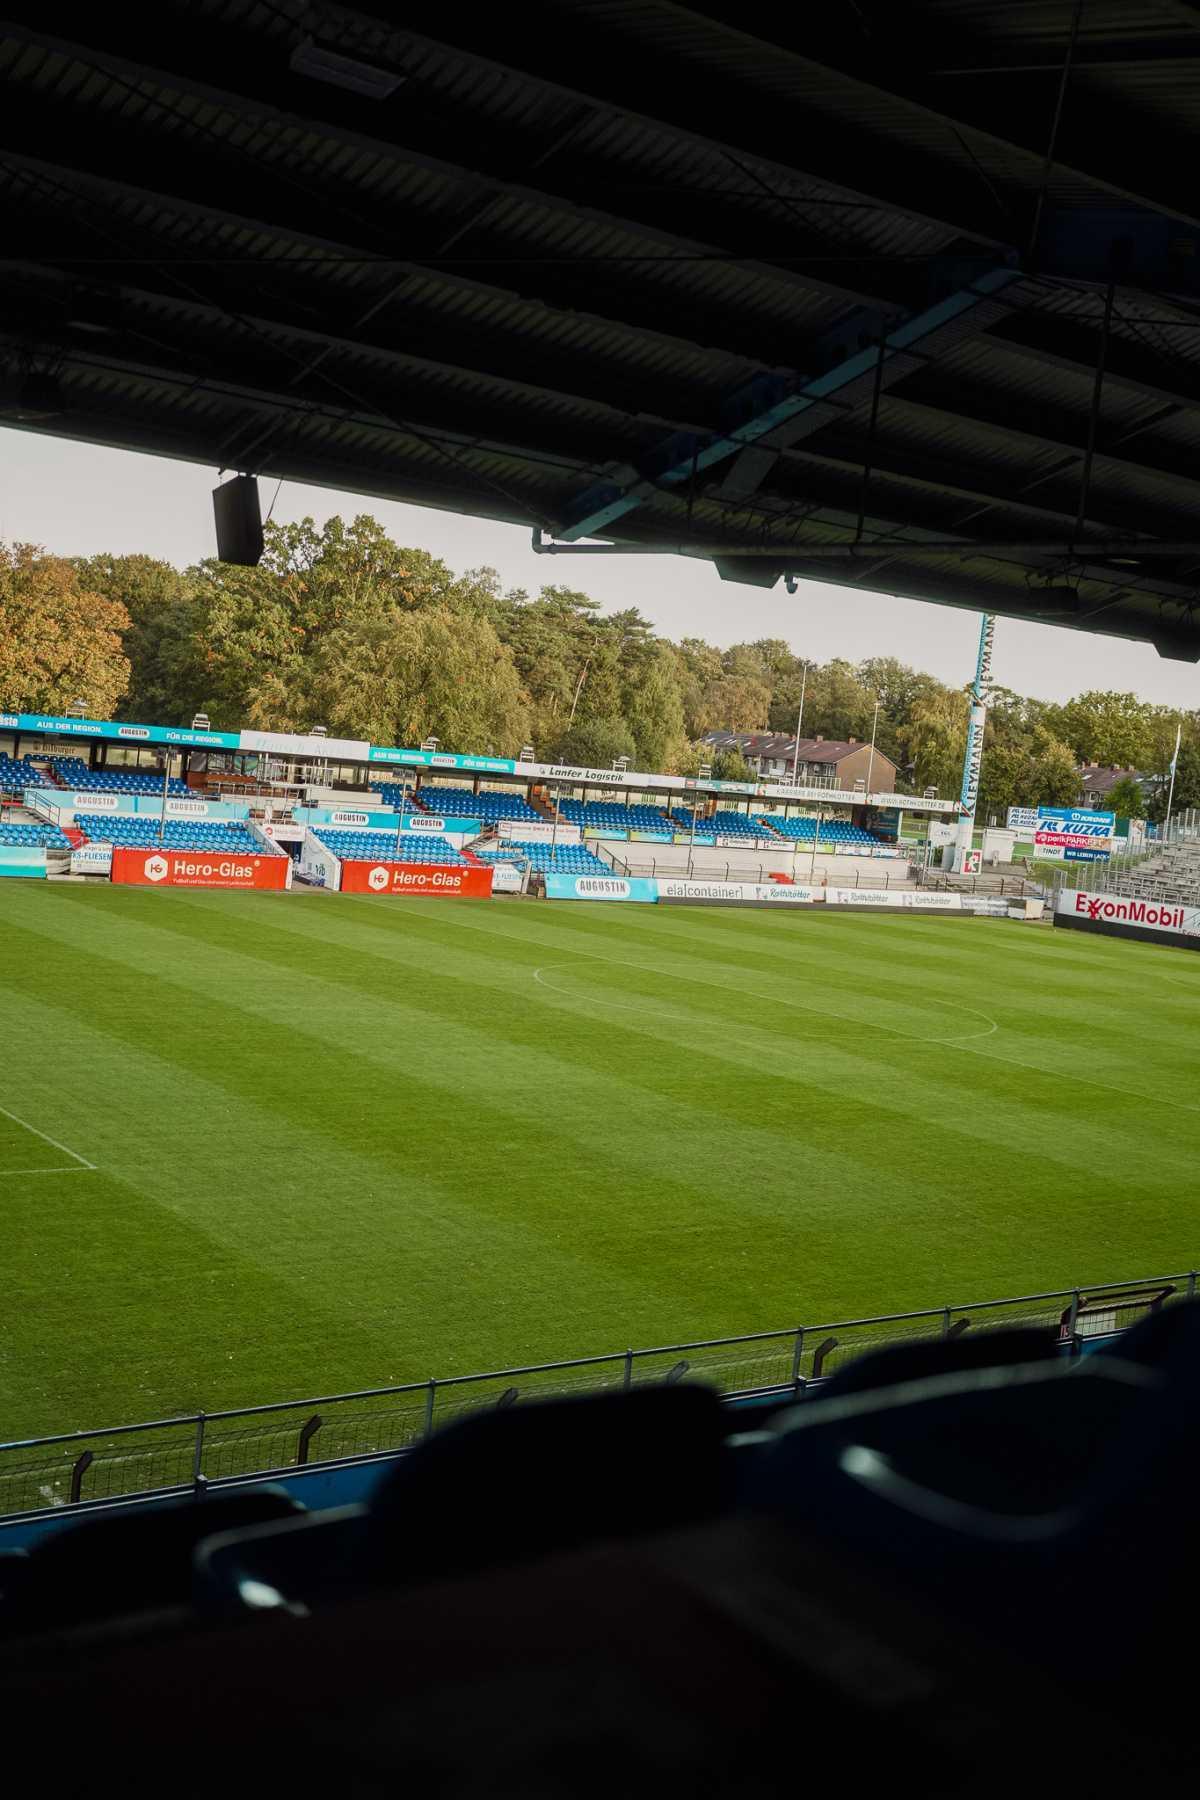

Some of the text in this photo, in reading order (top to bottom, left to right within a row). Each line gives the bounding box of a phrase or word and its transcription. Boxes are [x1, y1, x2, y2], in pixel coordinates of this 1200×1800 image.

[37, 721, 54, 729] AUS
[120, 727, 147, 736] AUGUSTIN
[548, 767, 625, 782] Lanfer Logistik
[76, 796, 115, 806] AUGUSTIN
[169, 802, 205, 812] AUGUSTIN
[334, 813, 367, 823] AUGUSTIN
[411, 818, 443, 827] AUGUSTIN
[1061, 822, 1111, 837] KUZKA
[173, 860, 253, 878] Hero-Glas
[393, 870, 462, 886] Hero-Glas
[580, 880, 626, 893] AUGUSTIN
[1075, 892, 1185, 929] ExxonMobil
